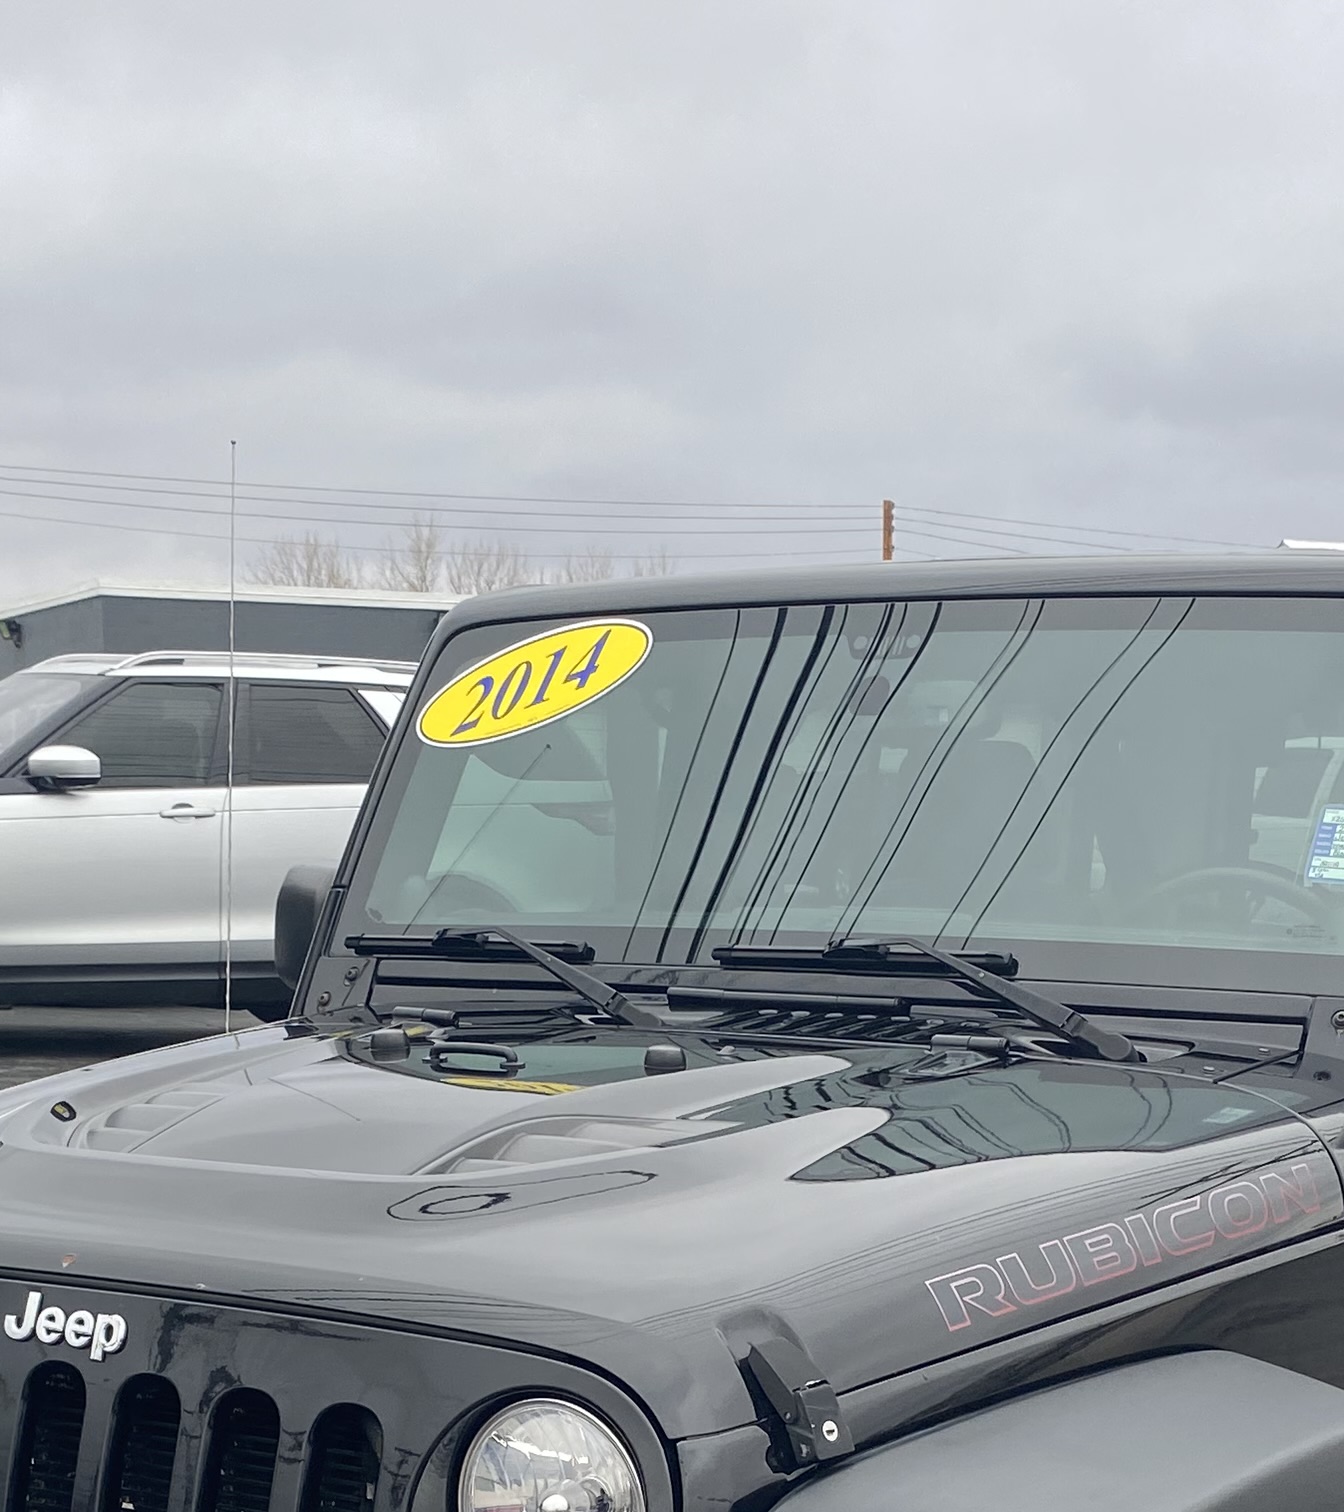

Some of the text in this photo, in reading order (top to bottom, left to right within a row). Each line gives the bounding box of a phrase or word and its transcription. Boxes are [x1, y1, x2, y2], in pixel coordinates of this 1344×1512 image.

[449, 628, 613, 738] 2014
[923, 1162, 1323, 1333] RUBICON
[3, 1290, 130, 1362] Jeep
